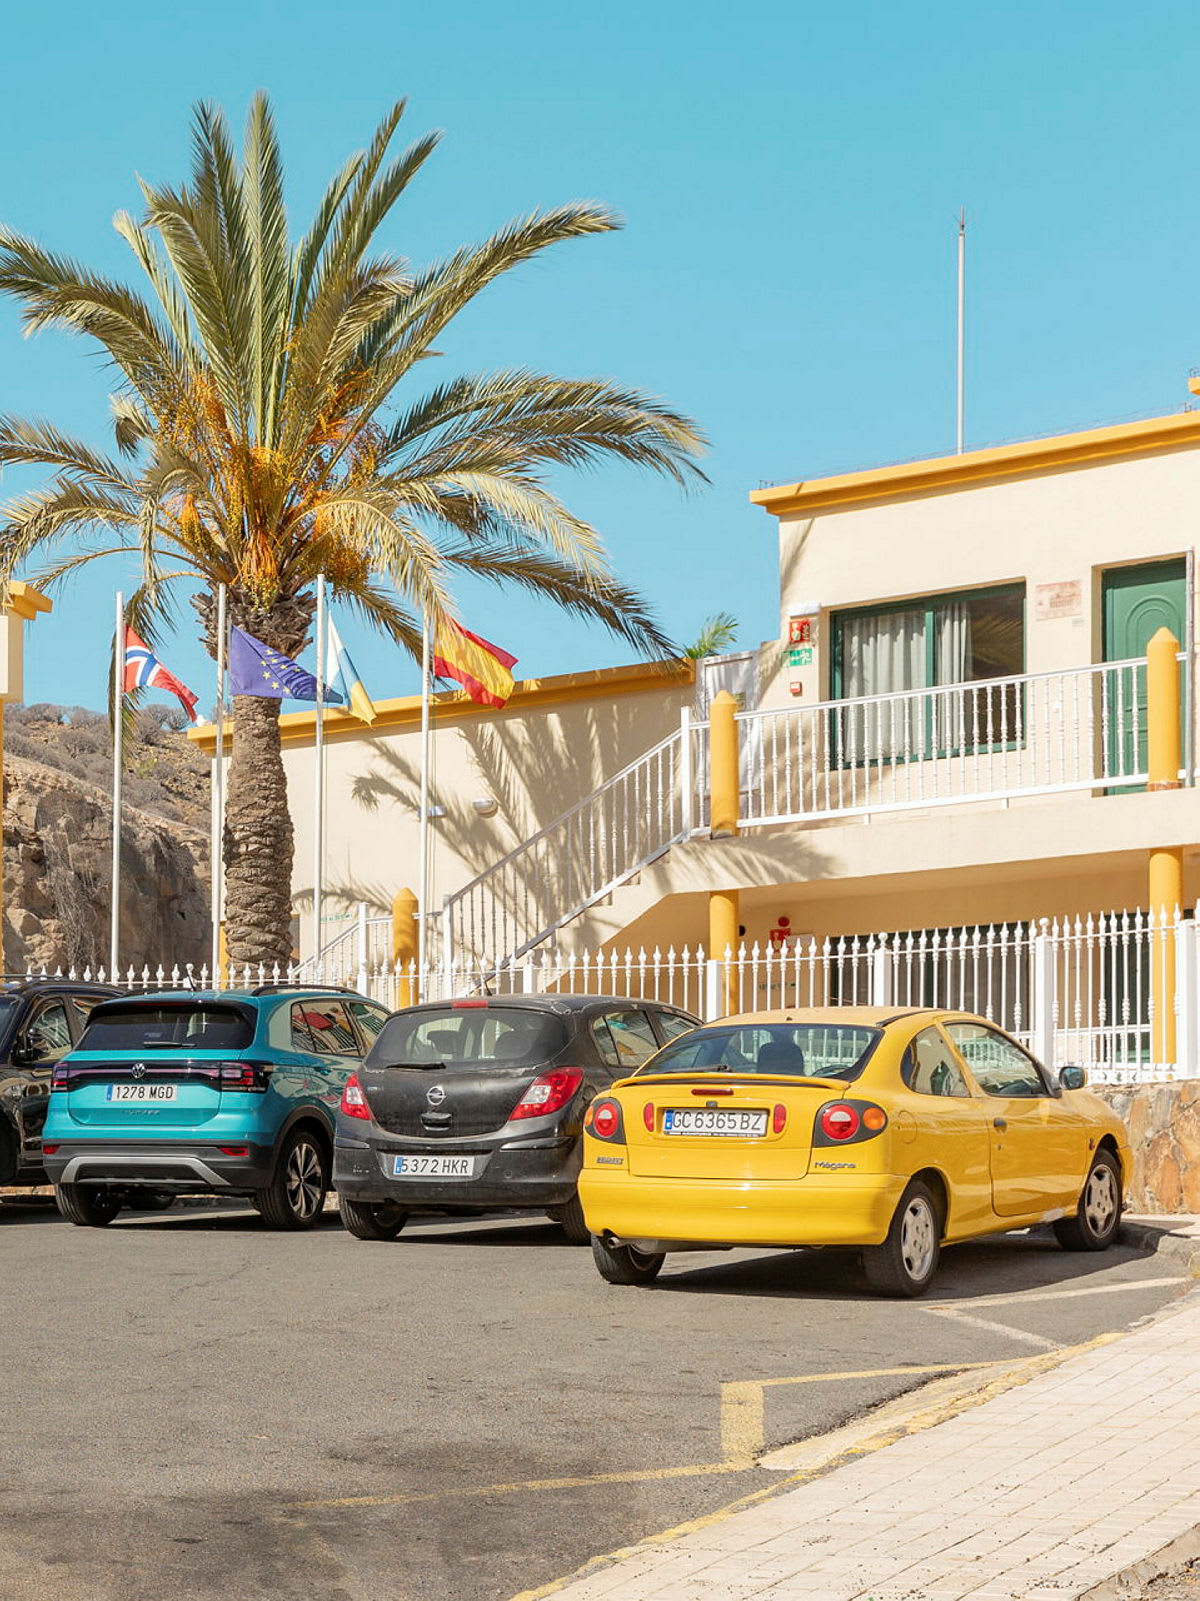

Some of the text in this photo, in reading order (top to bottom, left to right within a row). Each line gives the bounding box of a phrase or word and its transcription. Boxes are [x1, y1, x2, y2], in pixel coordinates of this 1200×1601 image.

[117, 1086, 174, 1098] 1278 MGD
[673, 1111, 762, 1130] GC 6365 BZ
[401, 1158, 469, 1173] 5372 HKR
